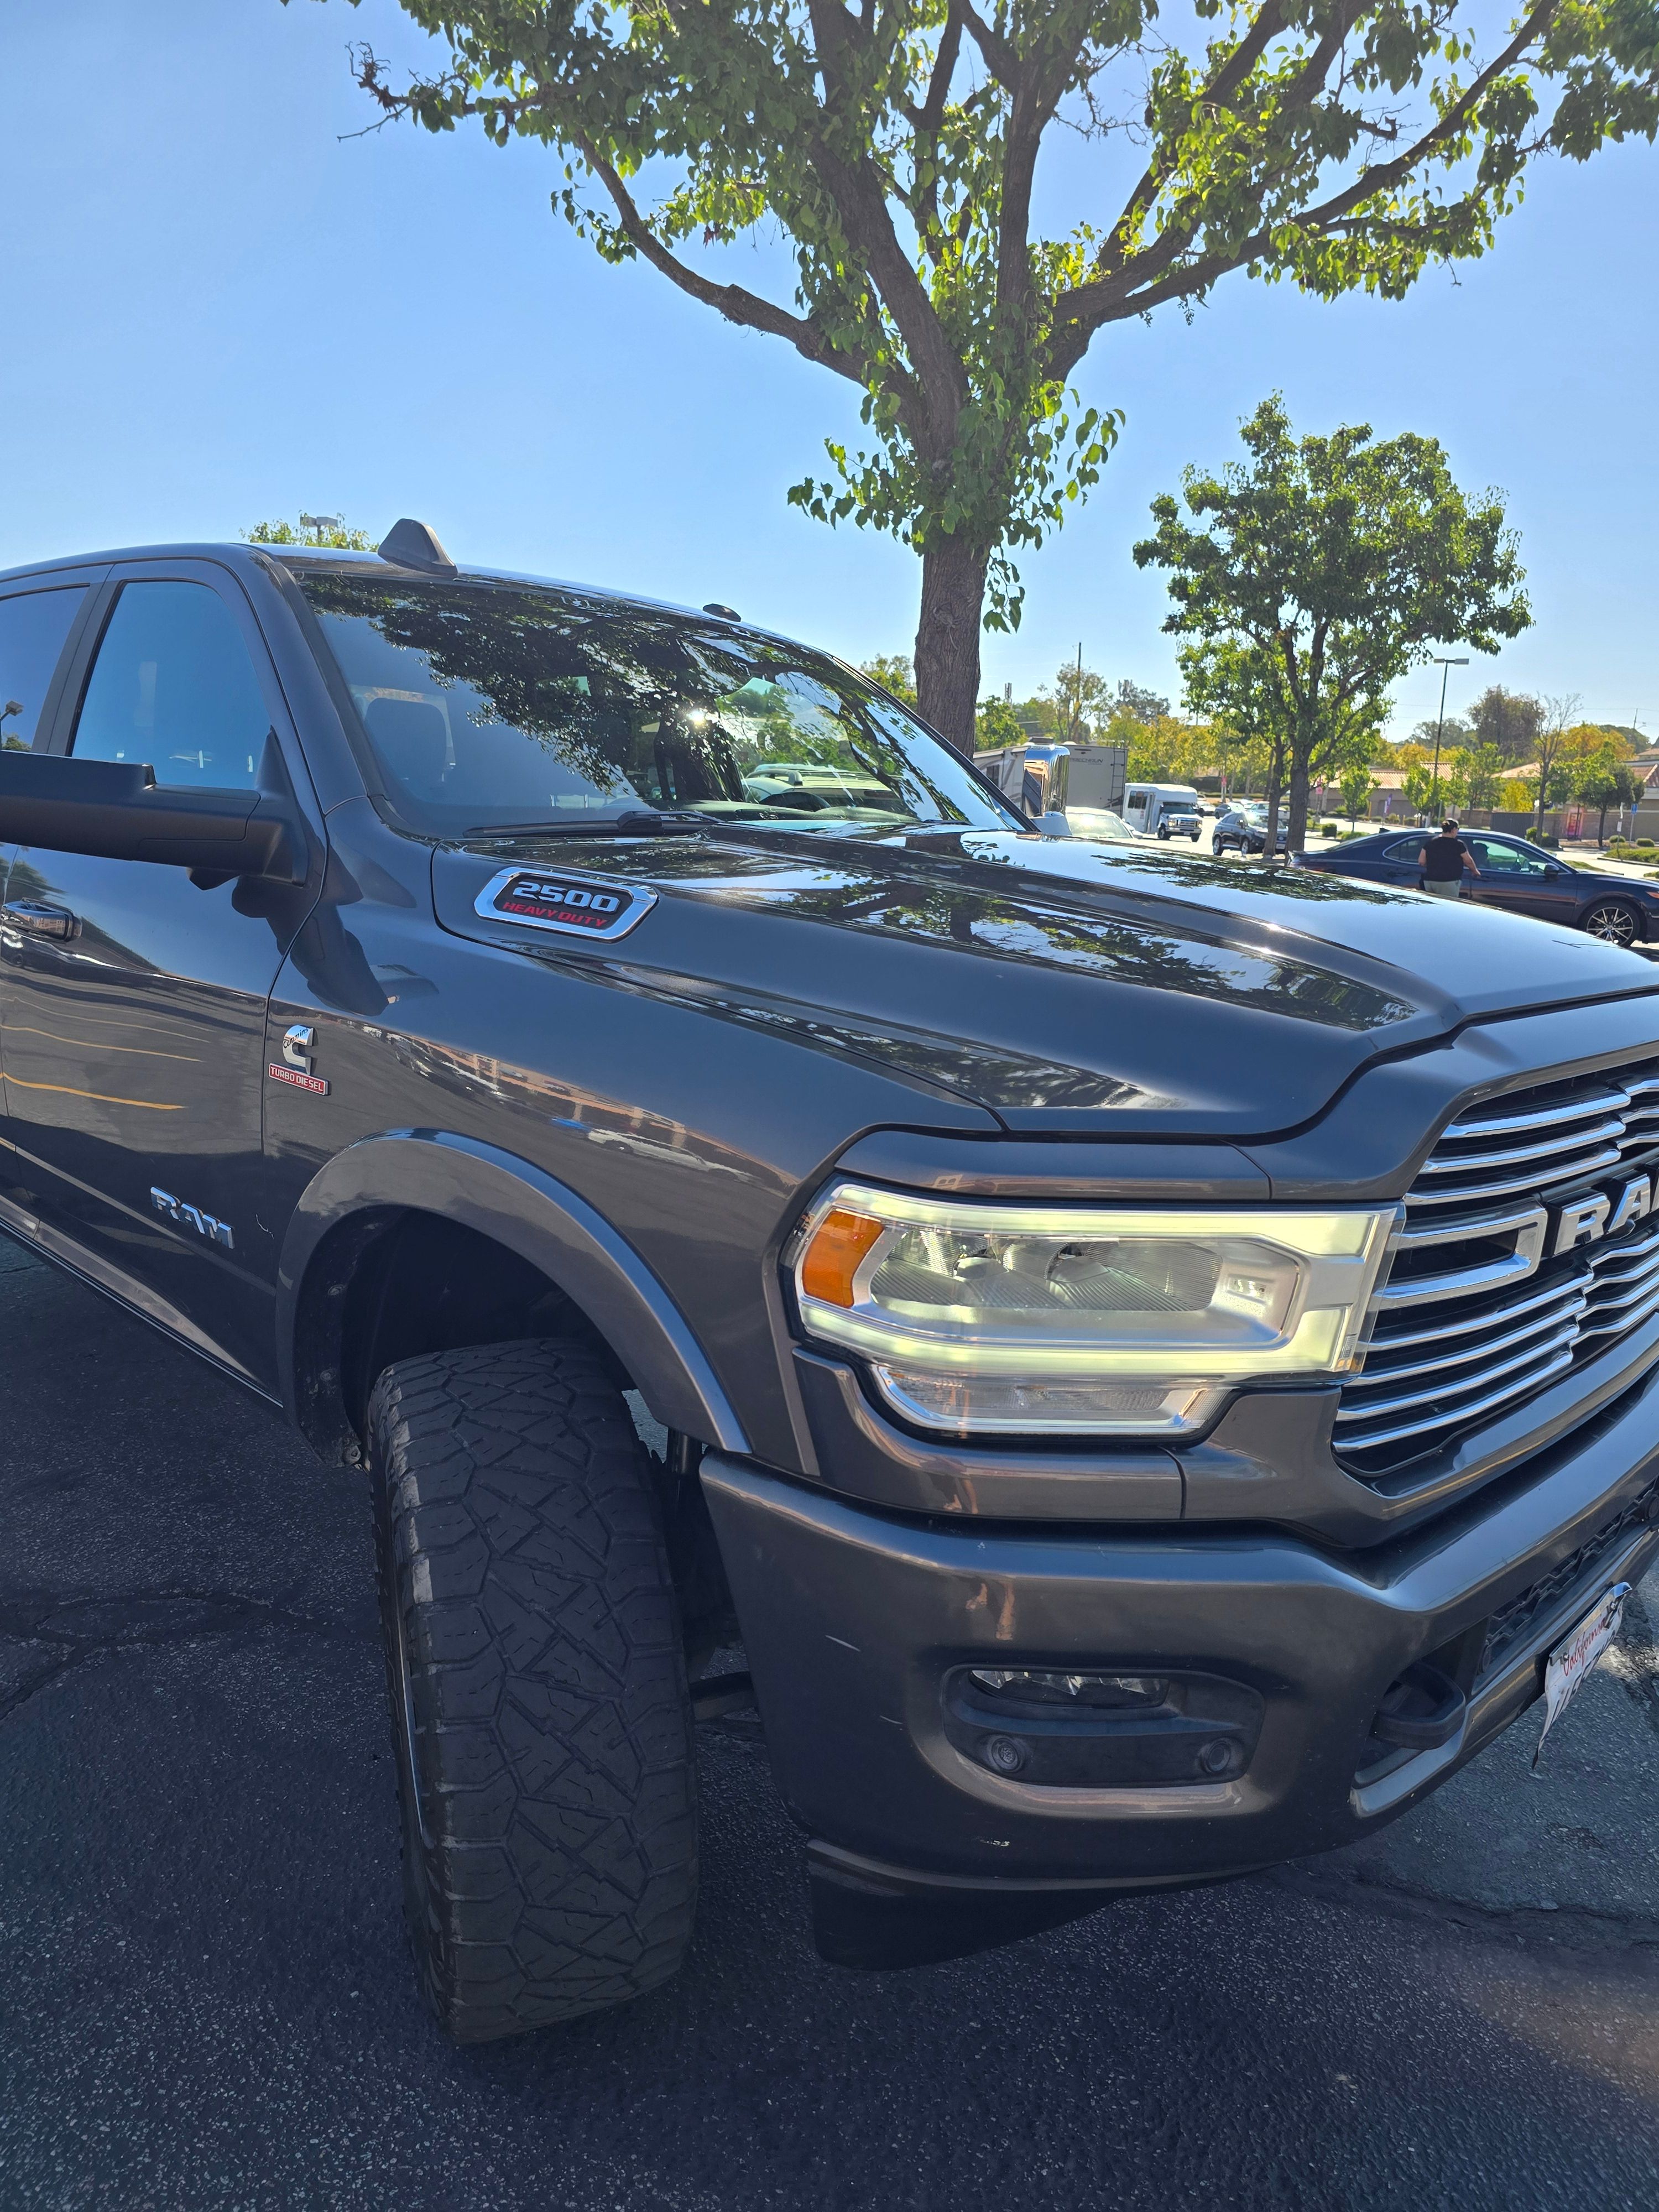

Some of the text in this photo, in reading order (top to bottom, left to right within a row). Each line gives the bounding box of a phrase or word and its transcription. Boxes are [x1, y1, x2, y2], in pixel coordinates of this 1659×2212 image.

[513, 881, 620, 913] 2500
[502, 902, 607, 927] HEAVY DUTY
[283, 1027, 309, 1049] Cummins
[270, 1067, 324, 1092] TURBO DIESEL
[150, 1186, 235, 1249] RAM
